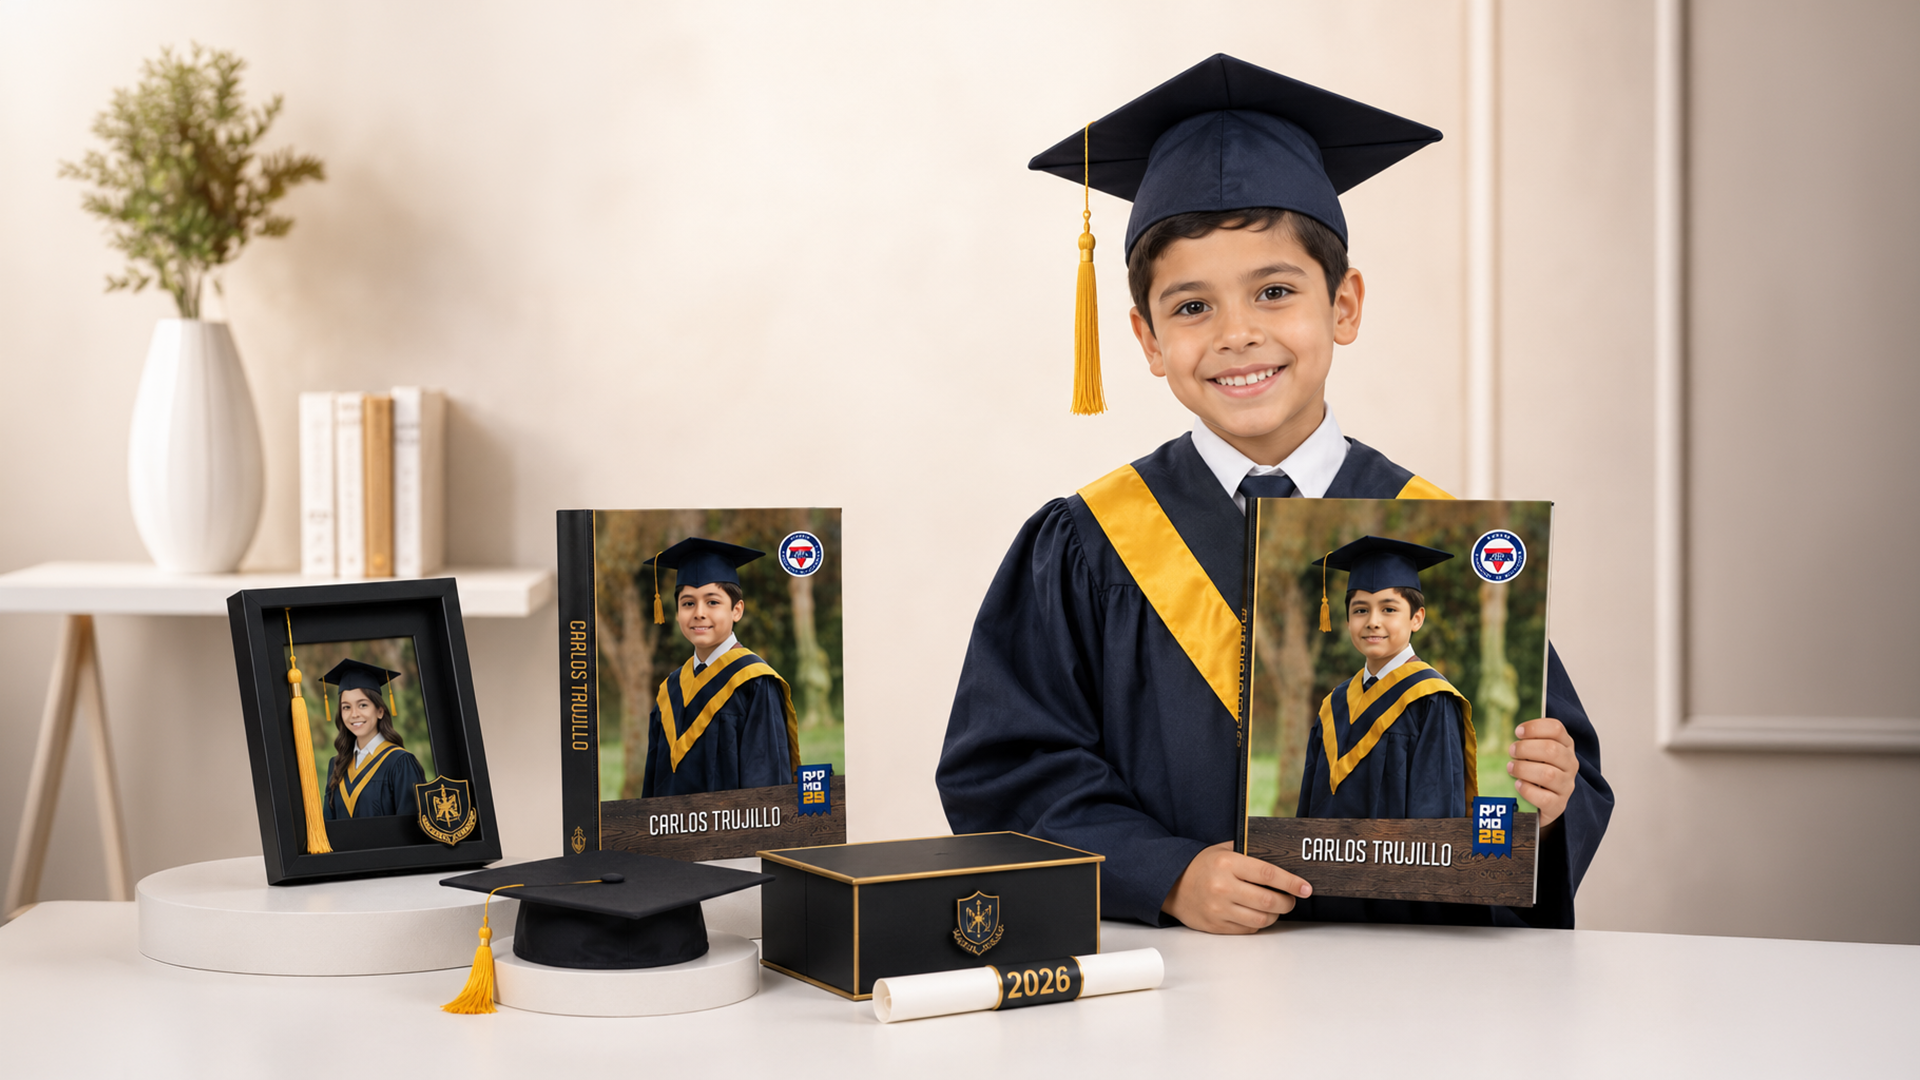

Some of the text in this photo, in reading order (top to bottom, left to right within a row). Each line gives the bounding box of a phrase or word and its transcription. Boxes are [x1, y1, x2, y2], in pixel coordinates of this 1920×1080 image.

[569, 621, 587, 680] CARLOS
[803, 782, 821, 792] MO
[650, 806, 781, 836] CARLOS TRUJILLO
[1479, 818, 1502, 829] MO
[1302, 837, 1452, 867] CARLOS TRUJILLO
[1007, 966, 1071, 999] 2026
